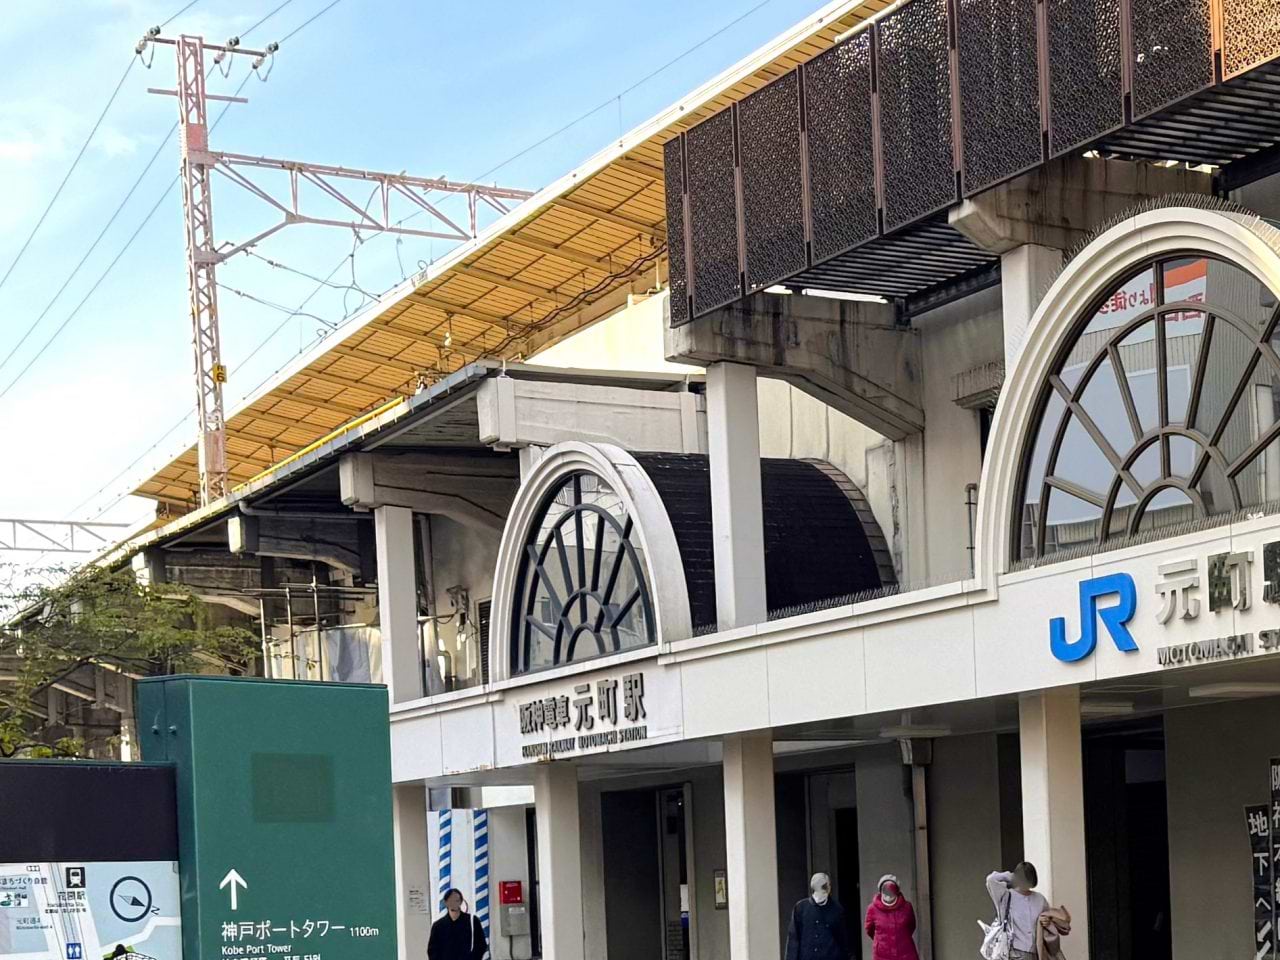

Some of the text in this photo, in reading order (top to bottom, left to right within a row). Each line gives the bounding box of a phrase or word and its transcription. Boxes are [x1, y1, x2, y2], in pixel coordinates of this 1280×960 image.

[1049, 572, 1140, 663] JR
[1157, 632, 1254, 666] MOTOMACHI
[619, 725, 648, 743] STATION
[1248, 810, 1272, 911] 地下へ
[222, 919, 379, 941] 神戸ポートタワー 1100m
[222, 943, 292, 955] Kobe Port Tower
